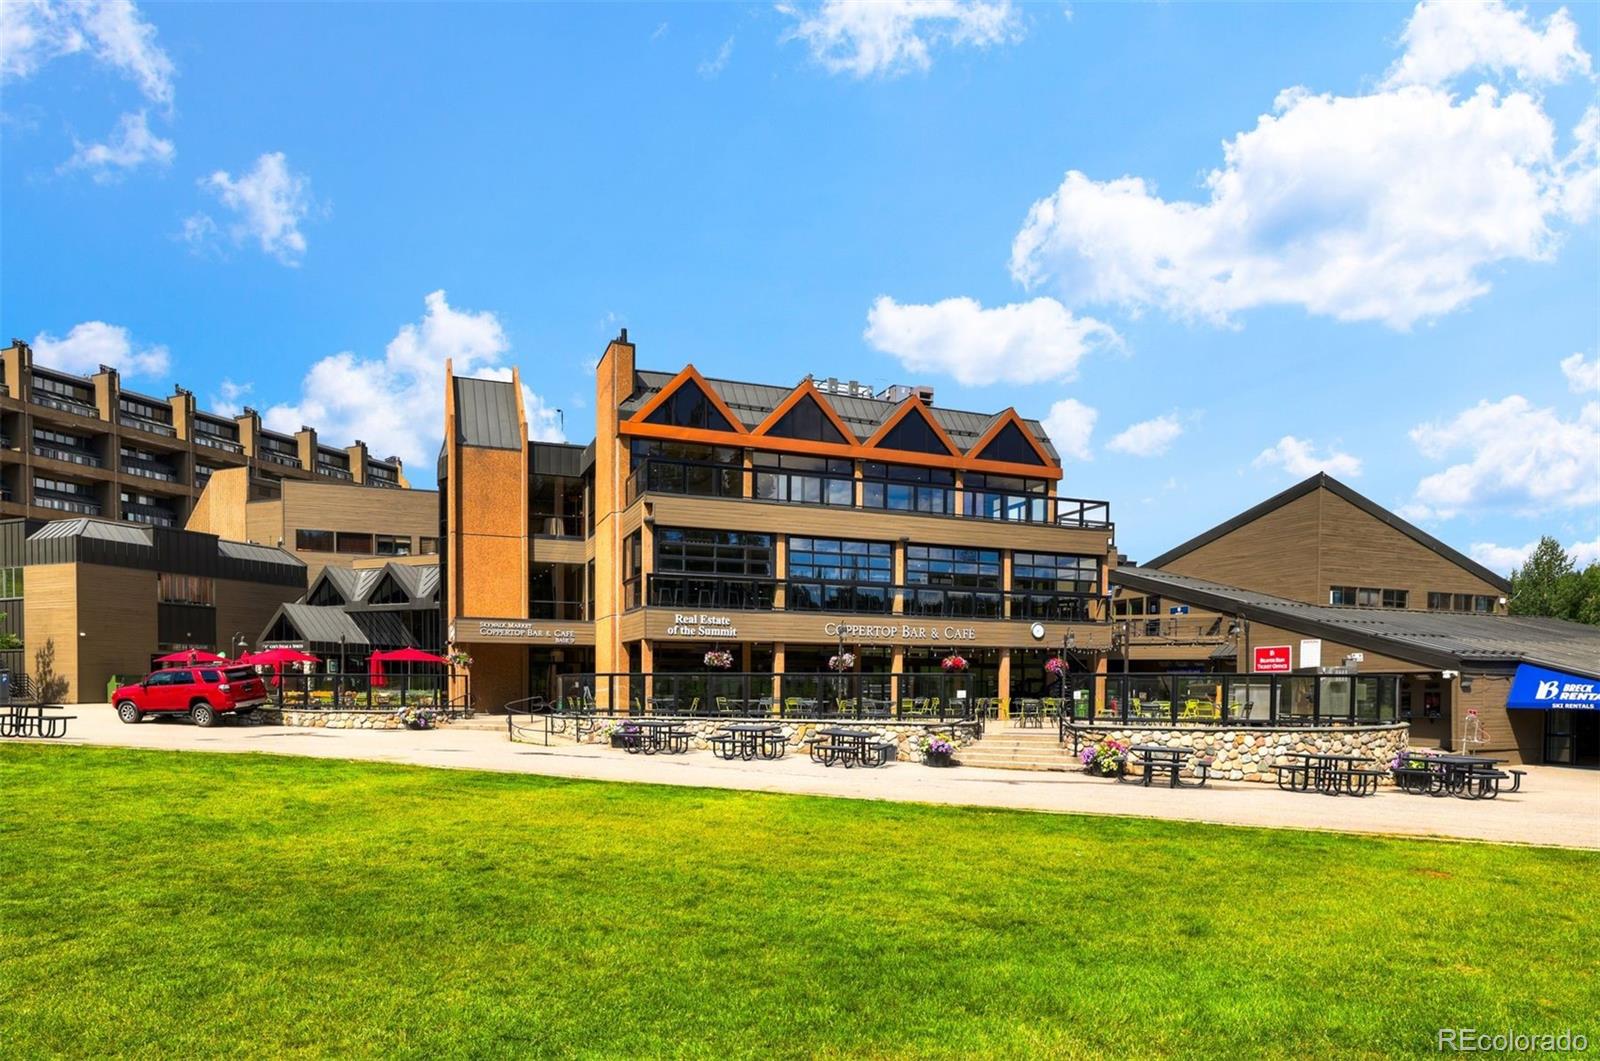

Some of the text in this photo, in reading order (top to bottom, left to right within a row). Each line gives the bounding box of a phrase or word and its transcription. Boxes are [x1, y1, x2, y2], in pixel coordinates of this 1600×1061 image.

[675, 613, 731, 625] Real Estate
[480, 628, 526, 636] COPPERTOP
[527, 628, 544, 637] BAR
[667, 625, 737, 637] of the Summit
[902, 624, 926, 638] BAR
[931, 627, 940, 639] &
[1563, 683, 1594, 692] BRECK
